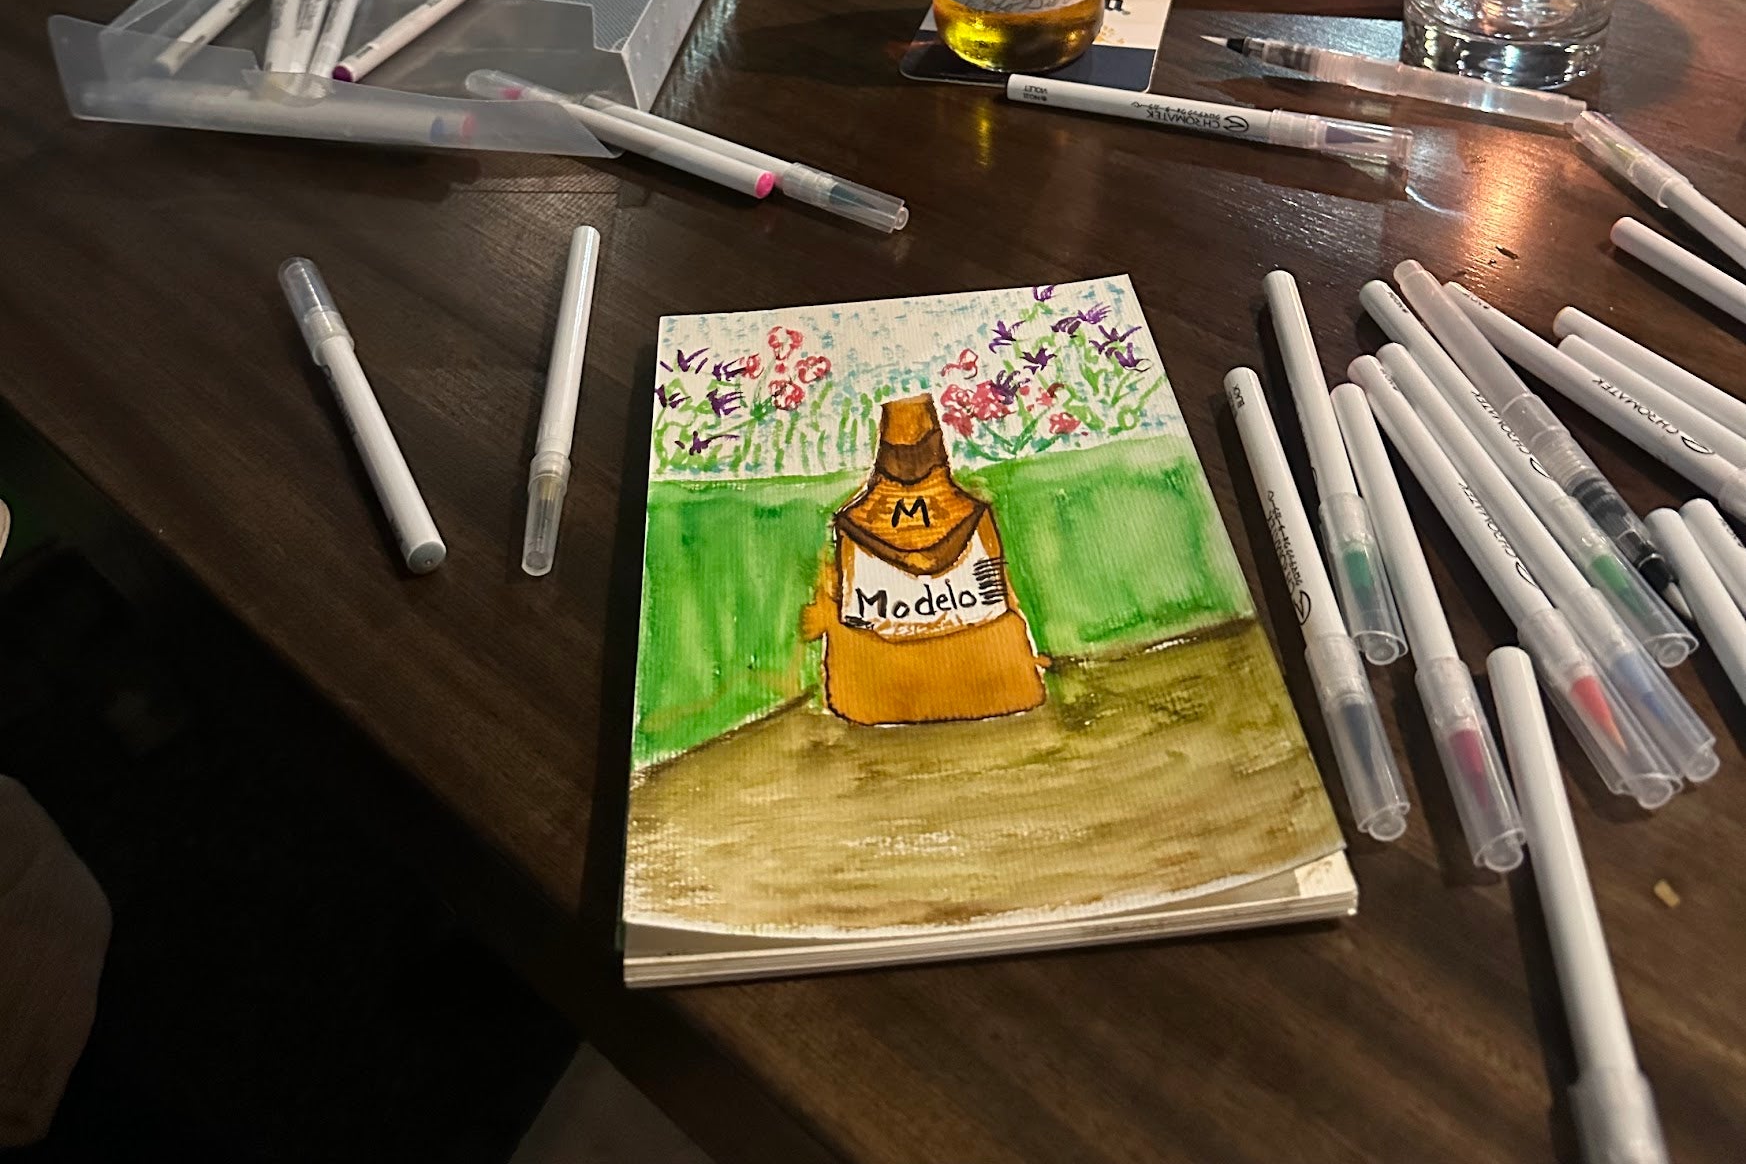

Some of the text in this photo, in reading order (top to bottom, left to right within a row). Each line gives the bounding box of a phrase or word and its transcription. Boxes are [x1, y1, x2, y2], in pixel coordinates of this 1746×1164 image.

[1144, 107, 1221, 129] CHROMATEK
[1593, 377, 1680, 434] CHROMATEK
[891, 496, 931, 528] M
[855, 578, 977, 618] Modelo
